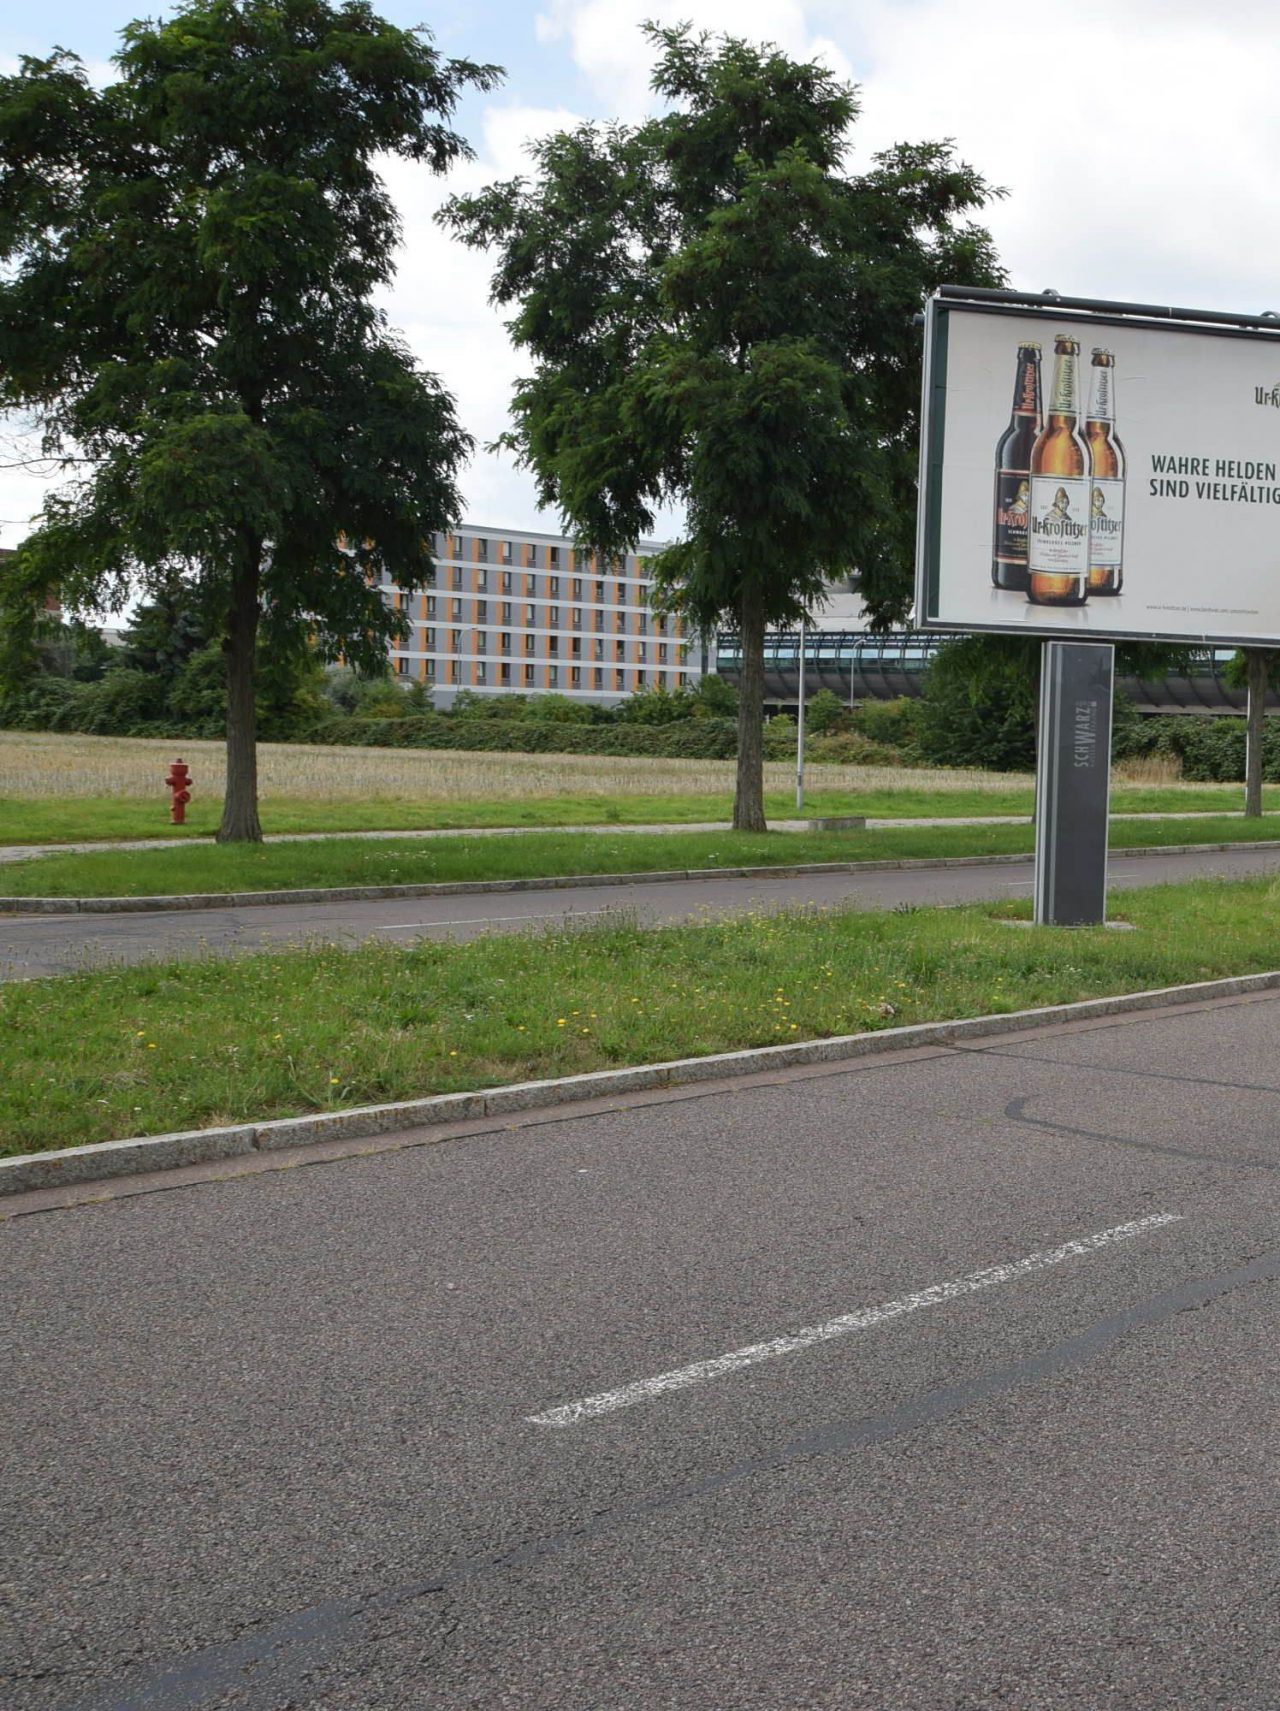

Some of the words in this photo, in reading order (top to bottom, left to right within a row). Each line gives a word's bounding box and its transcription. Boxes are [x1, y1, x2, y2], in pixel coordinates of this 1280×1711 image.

[1151, 455, 1210, 477] WAHRE
[1215, 459, 1277, 481] HELDEN
[1149, 478, 1190, 498] SIND
[1074, 707, 1096, 768] SCHWARZ
